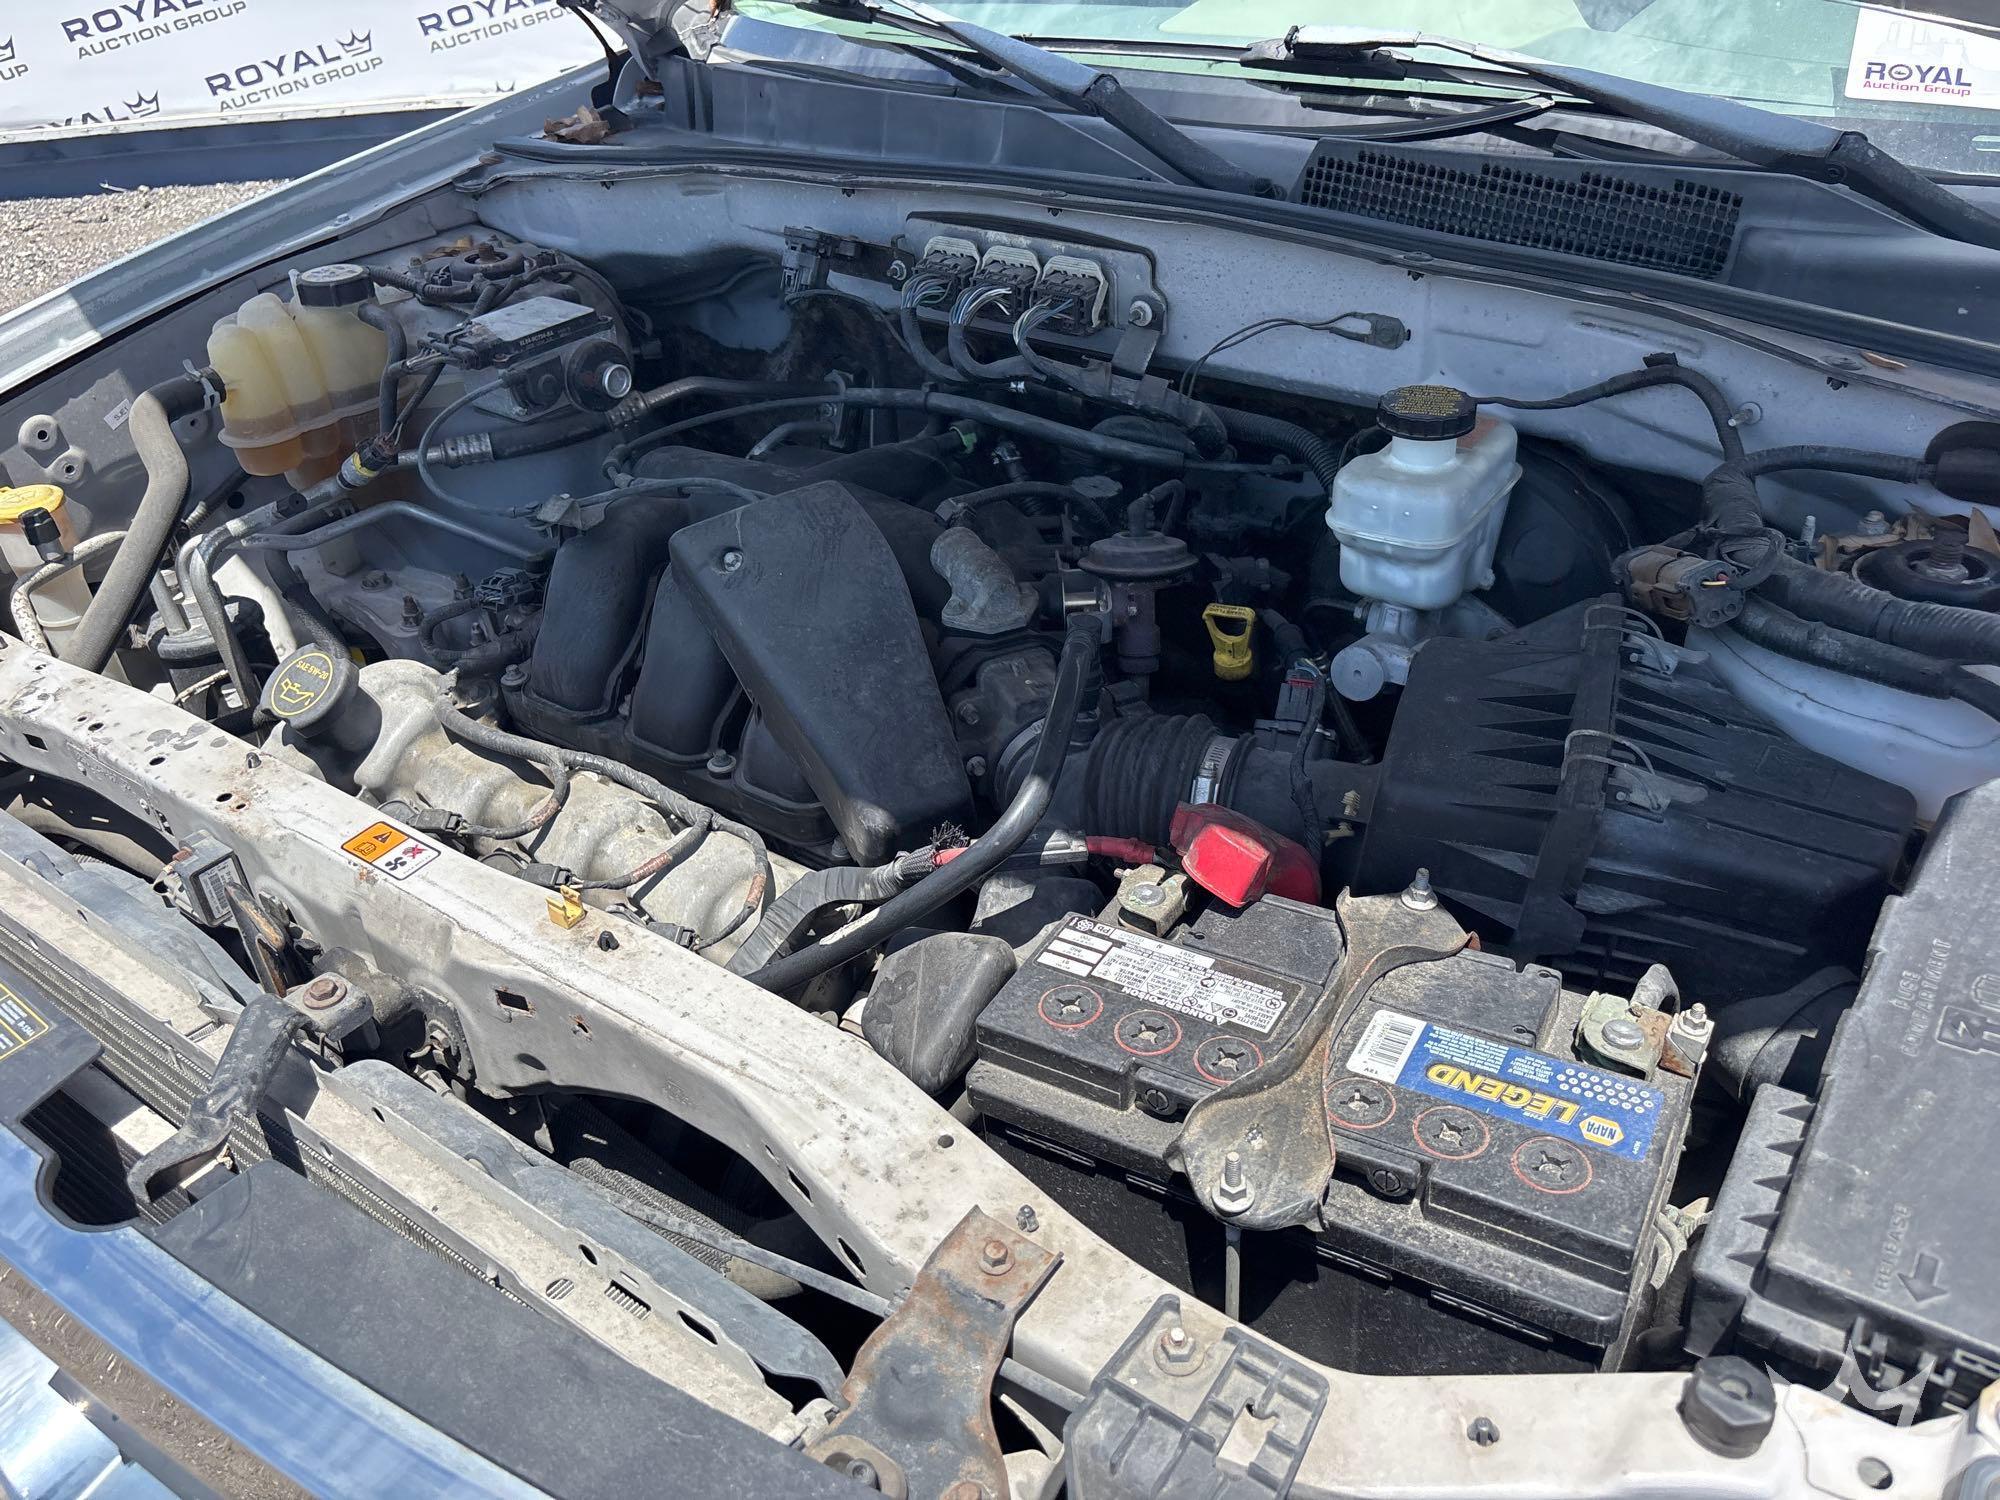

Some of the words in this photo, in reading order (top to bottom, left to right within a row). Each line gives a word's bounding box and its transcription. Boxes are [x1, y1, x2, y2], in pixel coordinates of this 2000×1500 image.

[78, 22, 171, 60] AUCTION
[173, 1, 247, 31] GROUP
[430, 18, 518, 53] AUCTION
[205, 44, 341, 97] ROYAL
[220, 77, 310, 112] AUCTION
[312, 56, 383, 86] GROUP
[1865, 62, 1972, 87] ROYAL
[1863, 80, 1920, 92] Auction
[1923, 84, 1971, 97] Group
[296, 660, 311, 672] SAE
[308, 664, 329, 680] 5W-20
[1095, 925, 1111, 933] Pb
[1119, 986, 1215, 1021] DANGER/POISON
[1900, 938, 1952, 1057] COMPARTMENT
[1426, 1062, 1582, 1125] LEGEND
[1585, 1120, 1617, 1140] NAPA
[1874, 1204, 1912, 1291] RELEASE
